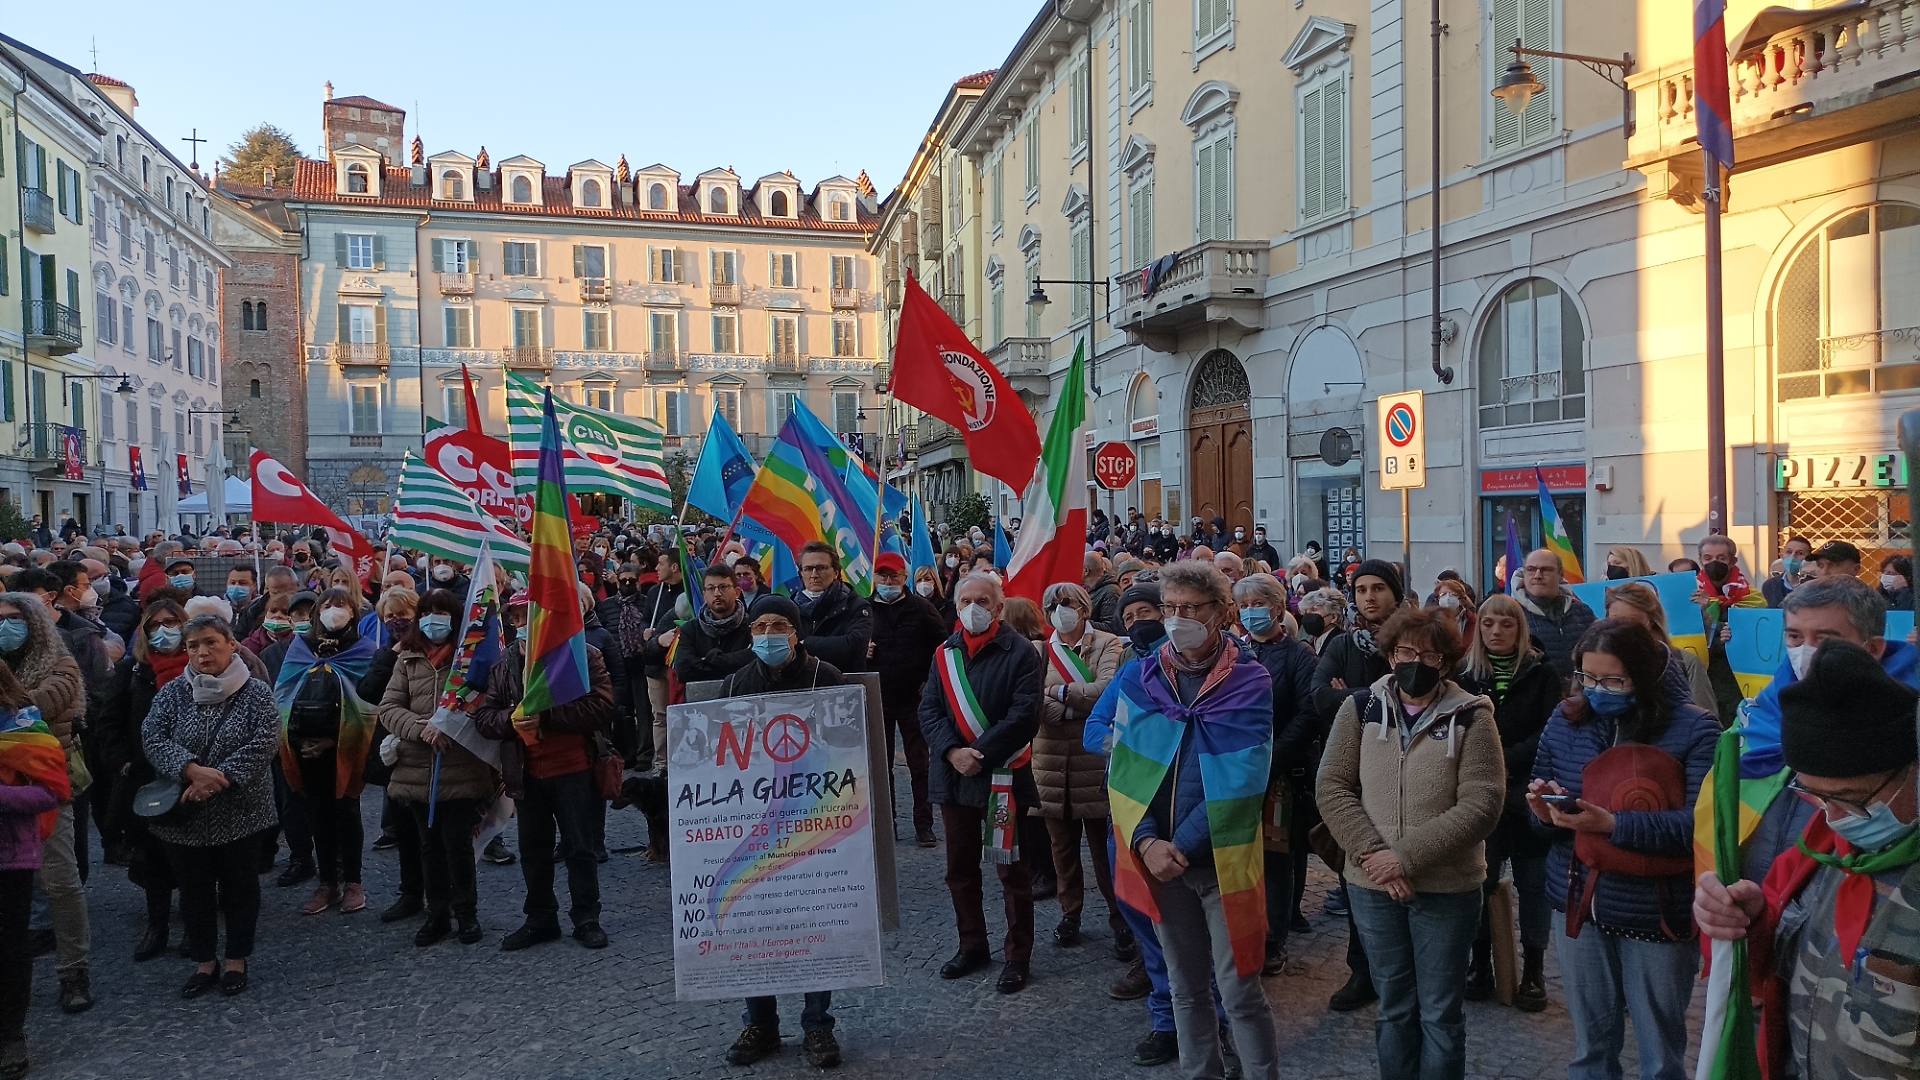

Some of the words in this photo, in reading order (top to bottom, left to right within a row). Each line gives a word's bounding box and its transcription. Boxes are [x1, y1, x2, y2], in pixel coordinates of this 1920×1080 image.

[573, 424, 614, 447] CISL
[1098, 456, 1134, 475] STOP
[460, 487, 533, 522] ORIO
[676, 778, 745, 810] ALLA
[752, 768, 857, 804] GUERRA
[678, 816, 711, 827] Davanti
[712, 813, 728, 823] alla
[730, 811, 767, 822] minaccia
[769, 809, 777, 819] di
[779, 808, 808, 820] guerra
[810, 805, 819, 814] in
[821, 803, 859, 813] l'Ucraina
[685, 825, 744, 843] SABATO
[751, 824, 769, 837] 26
[777, 814, 853, 834] FEBBRAIO
[748, 842, 769, 852] ore
[776, 837, 790, 849] 17
[703, 855, 731, 865] Presidio
[732, 853, 757, 863] davanti
[759, 852, 766, 861] al
[768, 850, 806, 860] Municipio
[808, 848, 816, 857] di
[817, 848, 837, 856] Ivrea
[754, 864, 766, 872] Per
[768, 862, 785, 870] dire:
[693, 874, 715, 889] NO
[716, 878, 729, 887] alle
[730, 876, 759, 885] minacce
[767, 874, 774, 882] ai
[775, 872, 814, 884] preparativi
[816, 870, 824, 878] di
[825, 869, 849, 881] guerra
[678, 892, 698, 906] NO
[698, 896, 705, 904] al
[707, 893, 752, 905] provocatorio
[753, 890, 783, 902] ingresso
[784, 888, 827, 898] dell'Ucraina
[828, 885, 846, 893] nella
[848, 884, 865, 892] Nato
[683, 909, 705, 924] NO
[715, 911, 731, 919] carri
[732, 909, 756, 918] armati
[757, 907, 774, 916] russi
[775, 906, 782, 914] al
[783, 904, 811, 914] confine
[812, 903, 825, 911] con
[826, 901, 858, 910] l'Ucraina
[679, 926, 699, 940] NO
[700, 929, 713, 937] alla
[715, 926, 748, 937] fornitura
[749, 925, 757, 933] di
[758, 924, 775, 933] armi
[776, 923, 789, 931] alle
[790, 922, 808, 931] parti
[809, 920, 817, 928] in
[818, 918, 849, 927] conflitto
[713, 943, 732, 951] attivi
[734, 941, 760, 950] l'Italia,
[762, 937, 794, 949] l'Europa
[803, 934, 827, 943] l'ONU
[730, 953, 743, 962] per
[748, 951, 773, 961] evitare
[775, 949, 783, 957] le
[784, 948, 812, 959] guerre.
